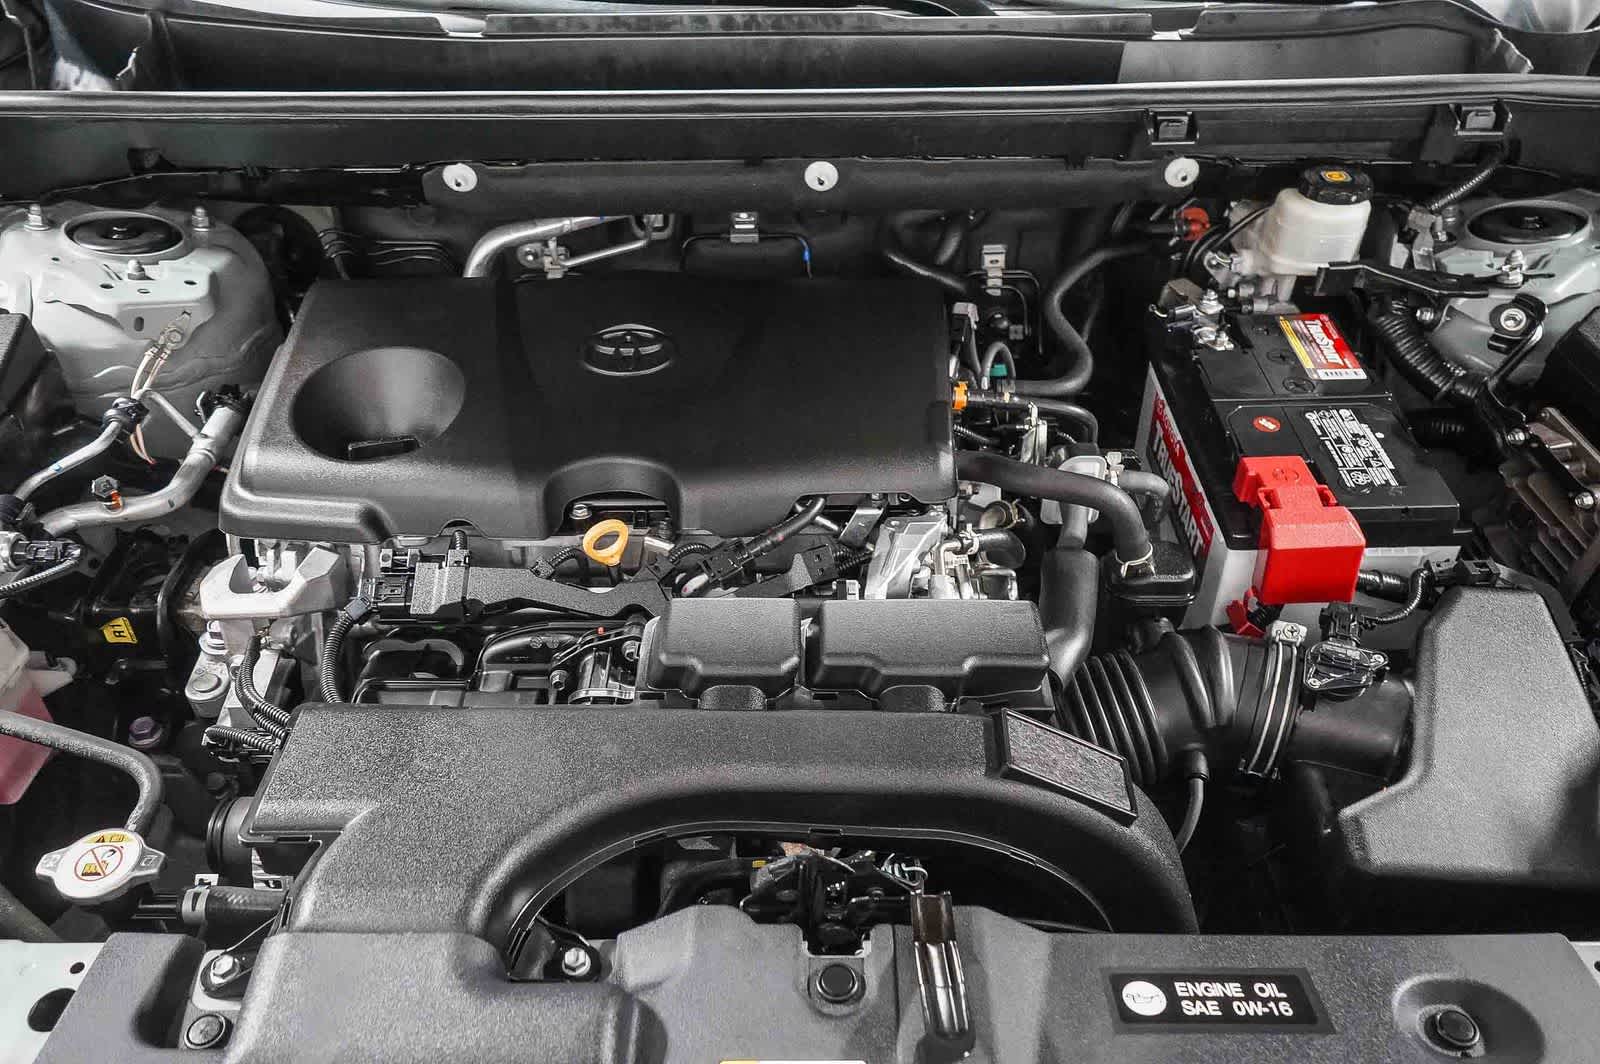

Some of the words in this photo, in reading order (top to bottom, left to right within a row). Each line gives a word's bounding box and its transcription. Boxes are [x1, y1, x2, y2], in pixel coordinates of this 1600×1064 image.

[1153, 420, 1204, 556] TRUESTART
[1174, 982, 1245, 998] ENGINE
[1252, 982, 1288, 999] OIL
[1181, 1000, 1223, 1017] SAE
[1232, 1001, 1294, 1017] 0W-16
